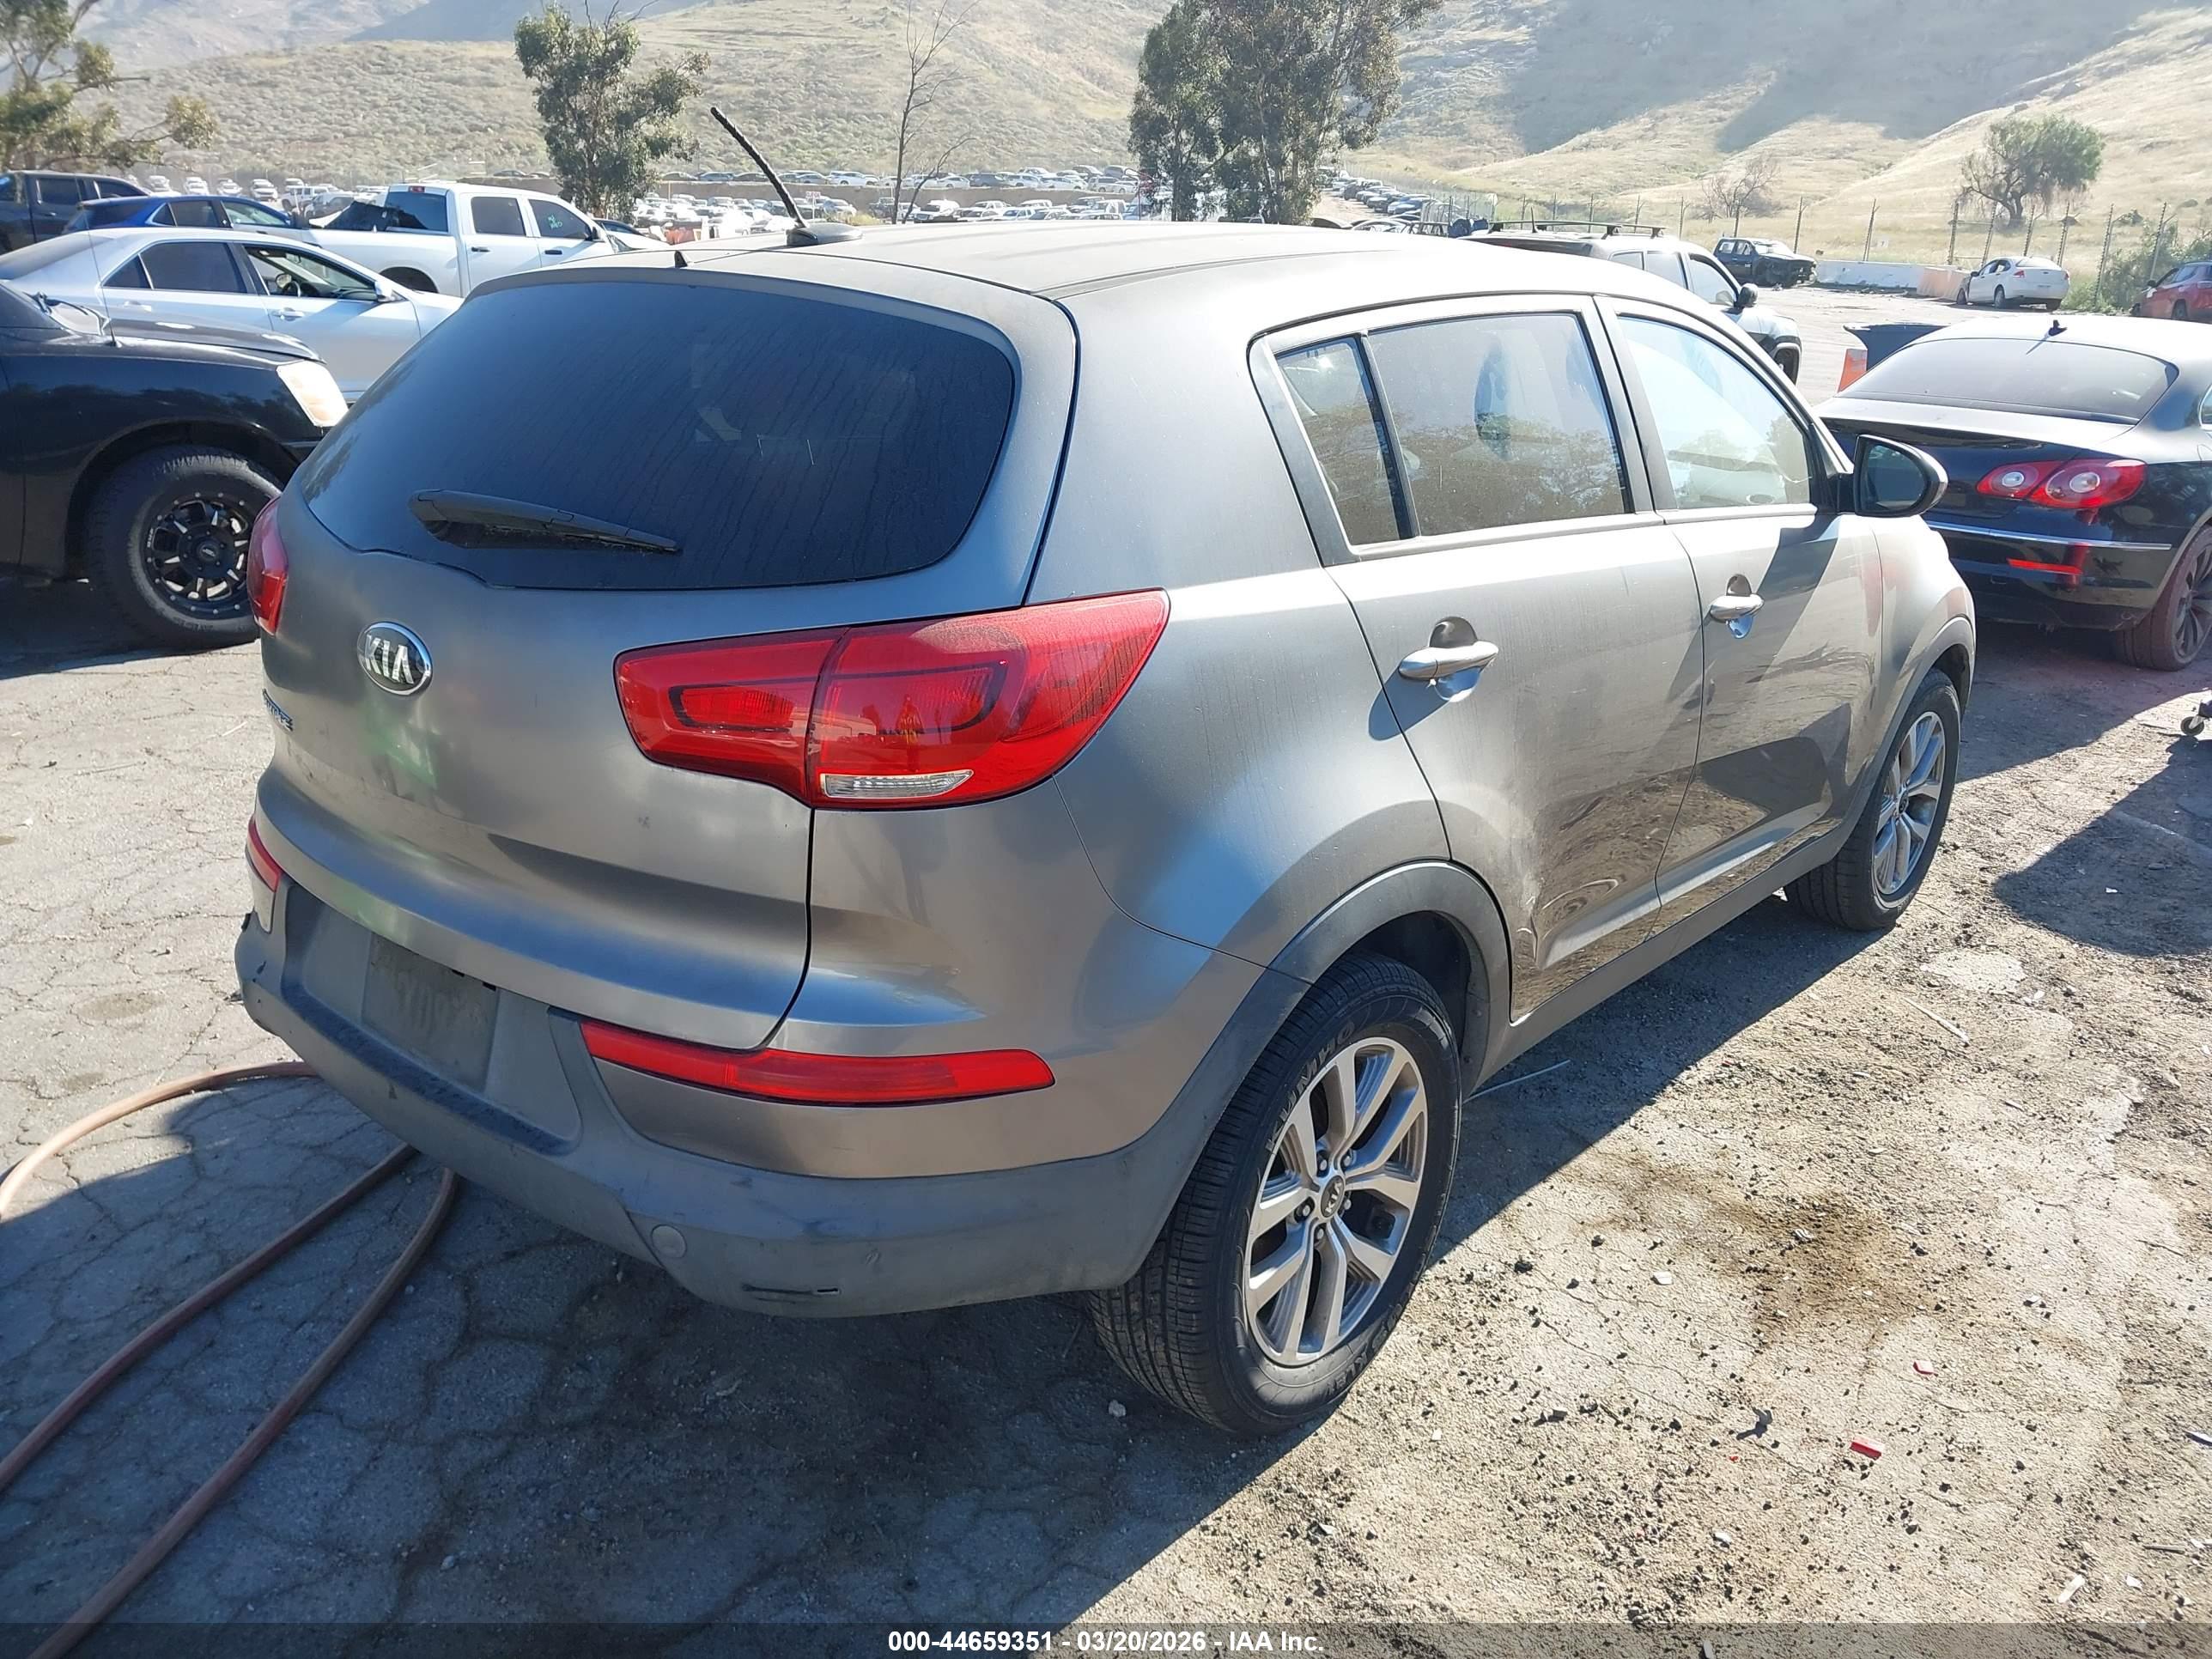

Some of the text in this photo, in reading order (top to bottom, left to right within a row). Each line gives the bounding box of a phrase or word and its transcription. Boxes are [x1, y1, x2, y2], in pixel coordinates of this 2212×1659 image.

[365, 634, 415, 684] KIA
[1265, 1021, 1355, 1152] KUMHO
[1325, 1182, 1342, 1213] KIA
